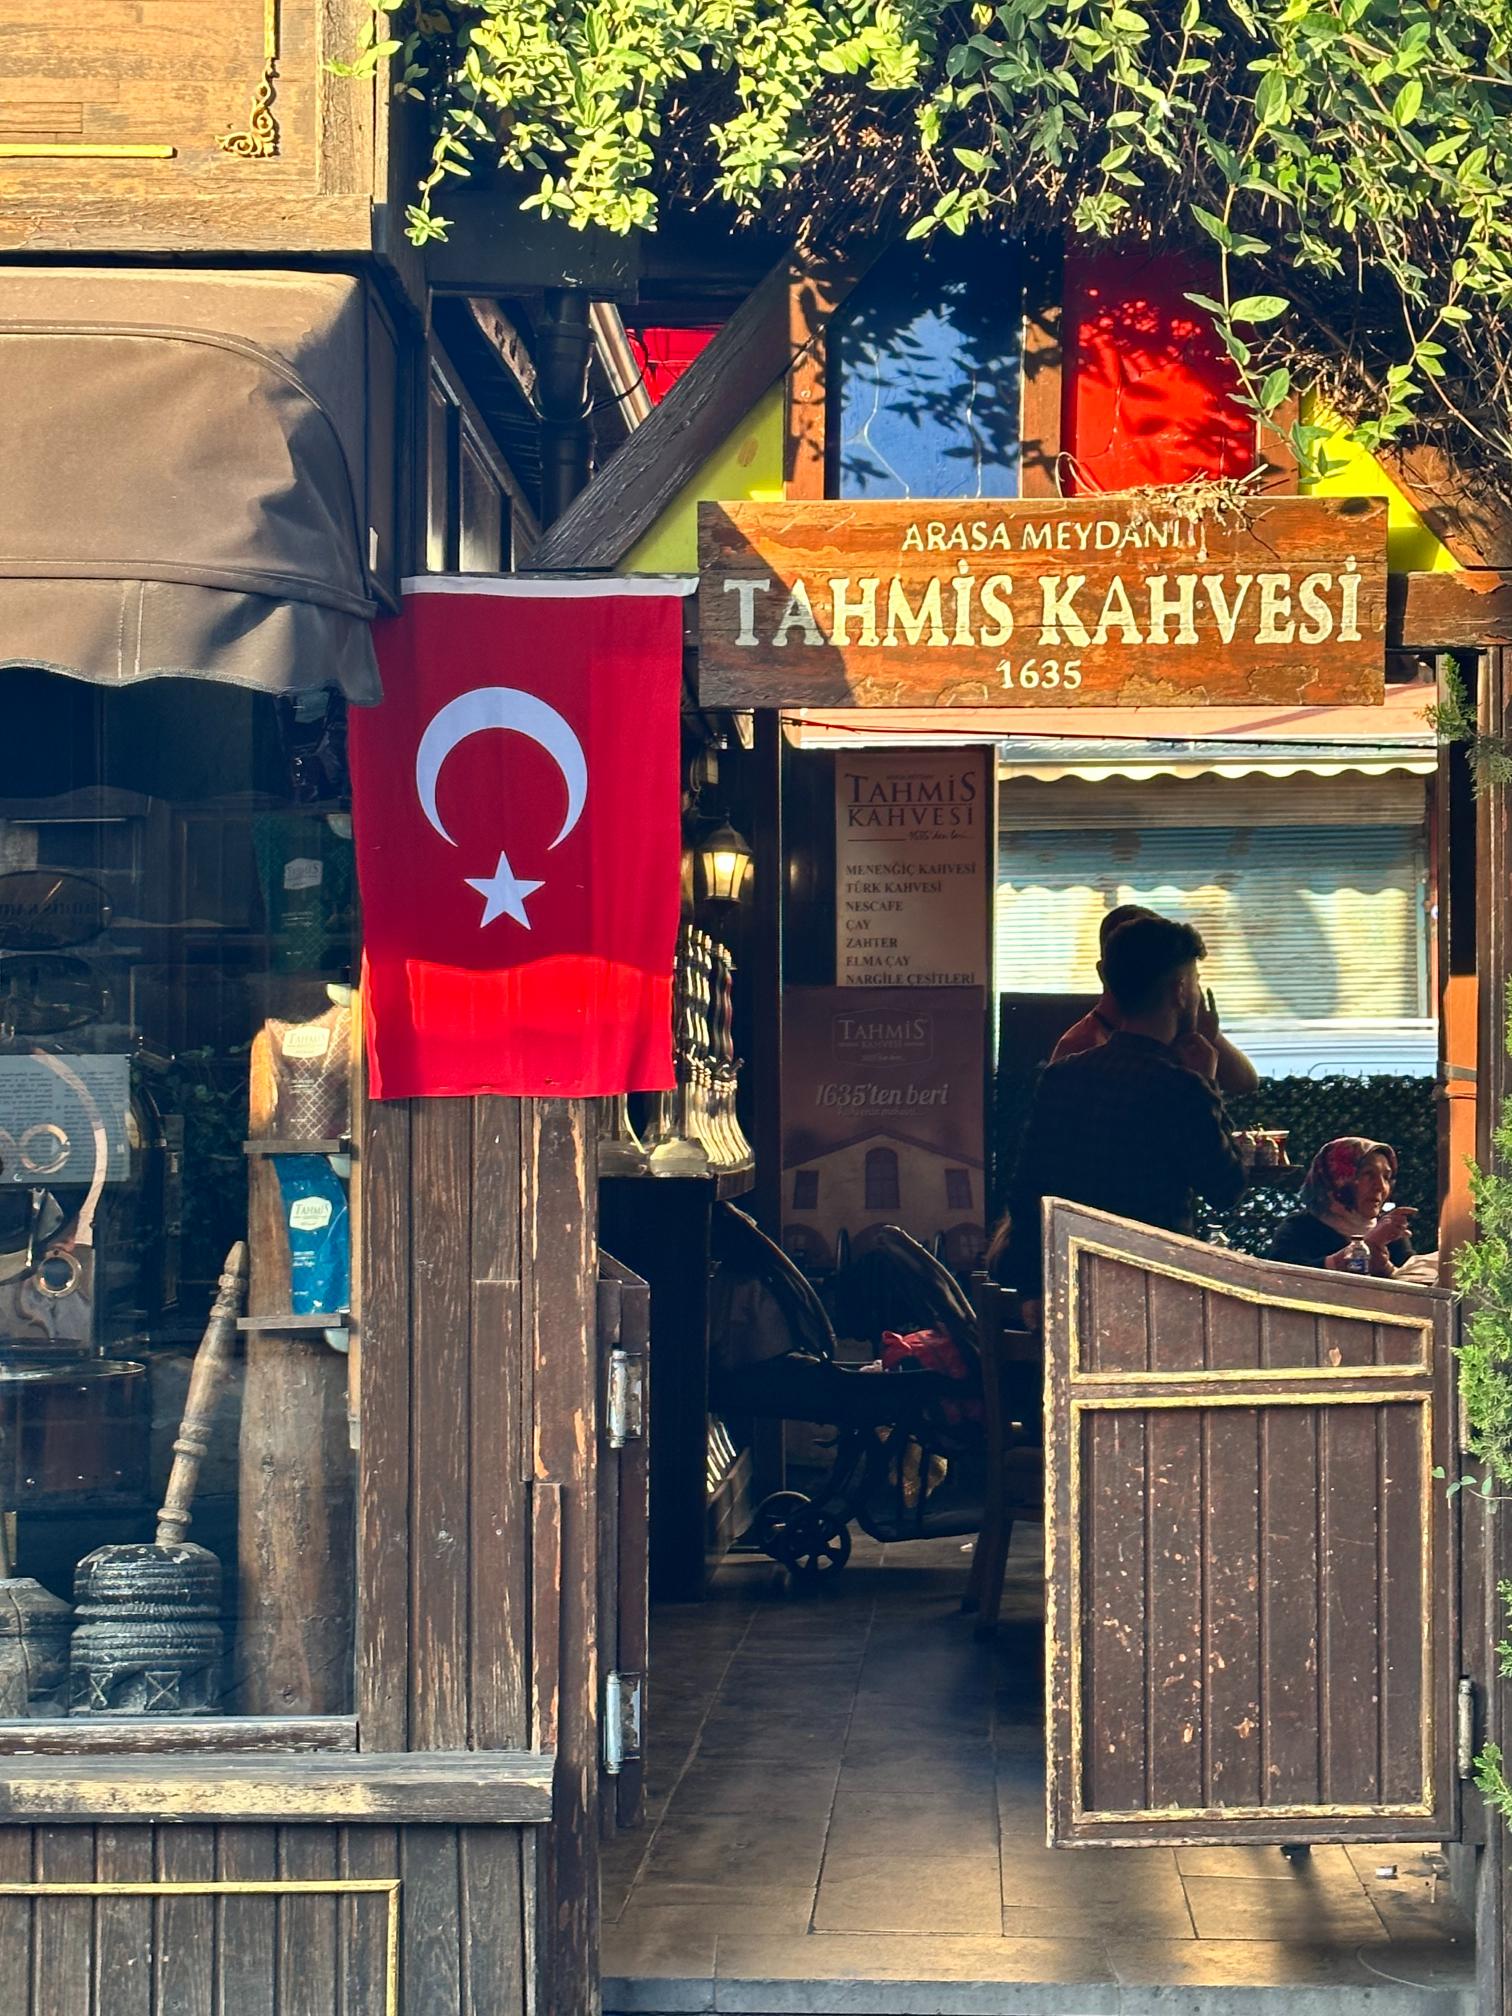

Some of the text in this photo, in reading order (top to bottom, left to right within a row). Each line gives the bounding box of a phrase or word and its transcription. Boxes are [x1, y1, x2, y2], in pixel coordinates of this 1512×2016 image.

[900, 519, 1181, 552] ARASA MEYDANI
[722, 554, 1364, 648] TAHMİS KAHVESİ
[996, 658, 1083, 690] 1635
[845, 771, 976, 803] TAHMİS
[847, 804, 974, 827] KAHVESİ
[919, 862, 976, 875] KAHVESİ
[846, 880, 942, 893] TÜRK KAHVESİ
[846, 919, 872, 931] ÇAY
[846, 938, 898, 949] ZAHTER
[846, 956, 911, 969] ELMA ÇAY
[846, 971, 904, 985] NARGİLE
[838, 1018, 928, 1041] TAHMİS
[816, 1082, 950, 1106] 1635'ten beri
